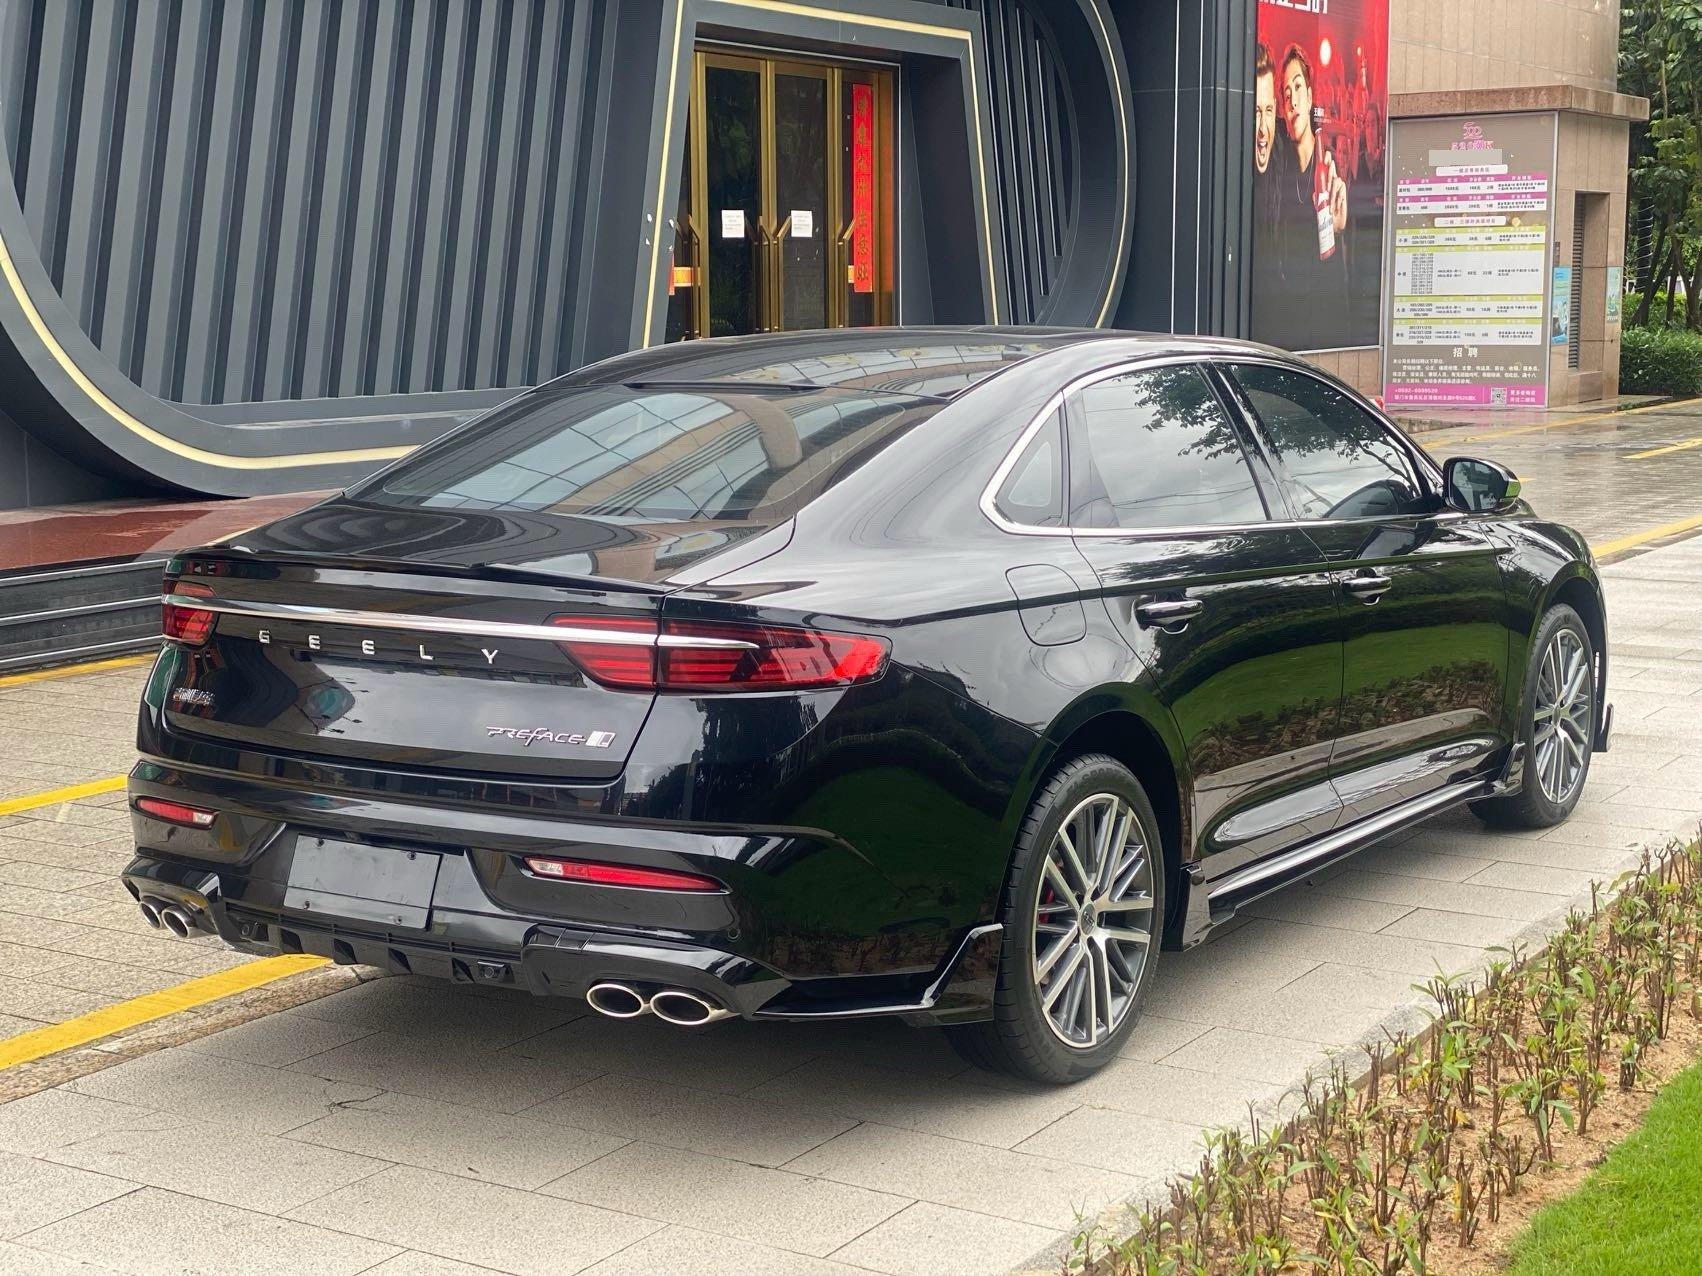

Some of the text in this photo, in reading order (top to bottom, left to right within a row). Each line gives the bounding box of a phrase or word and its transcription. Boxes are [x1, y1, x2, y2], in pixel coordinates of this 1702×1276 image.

[1453, 347, 1478, 358] 招聘
[259, 630, 499, 664] GEELY
[486, 726, 586, 747] PREFACE
